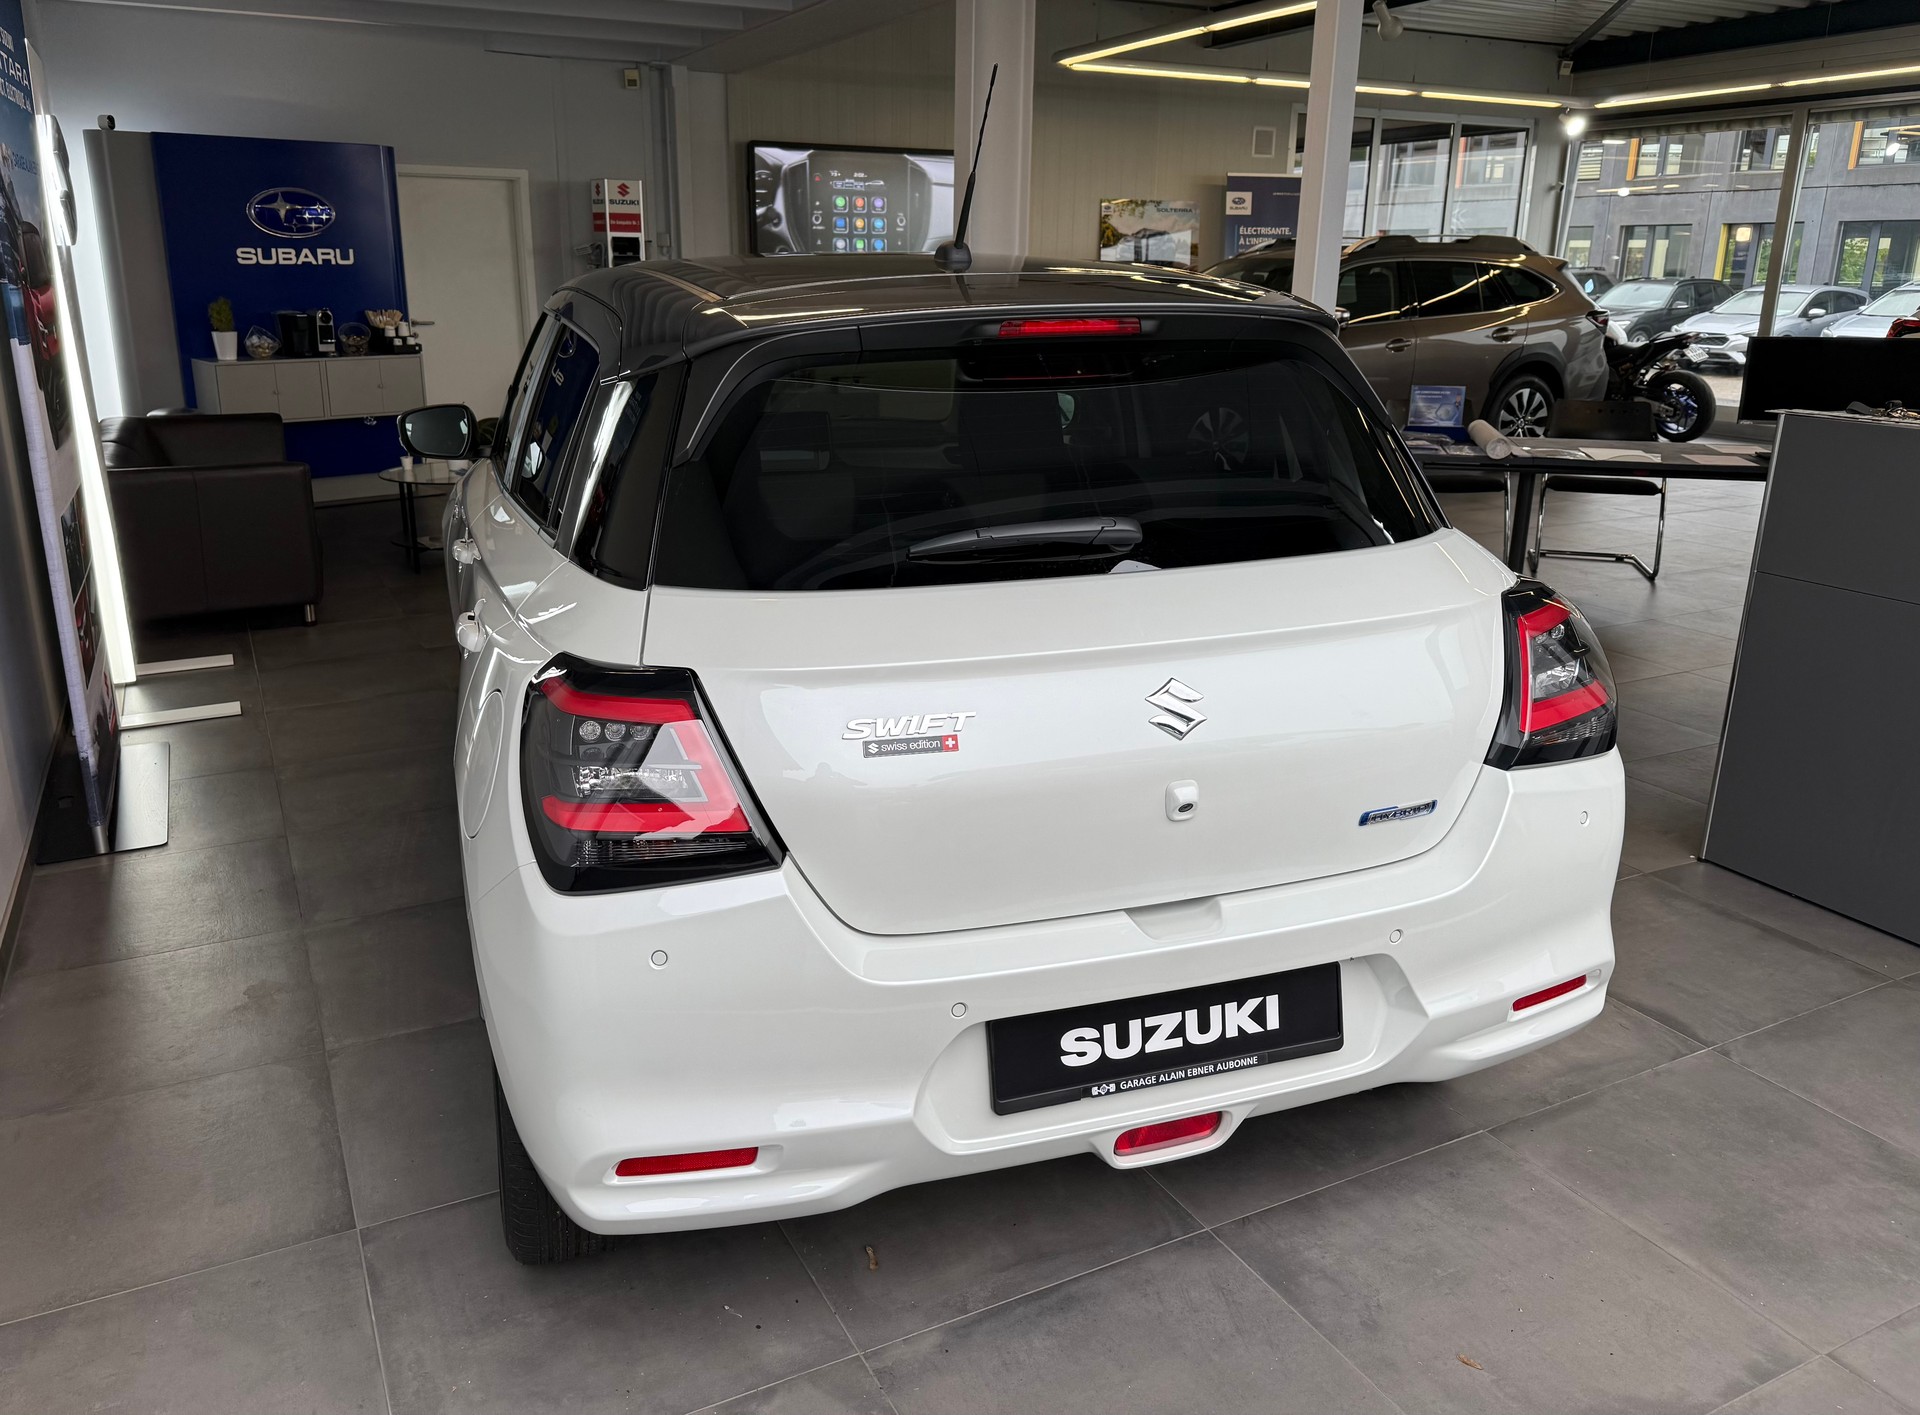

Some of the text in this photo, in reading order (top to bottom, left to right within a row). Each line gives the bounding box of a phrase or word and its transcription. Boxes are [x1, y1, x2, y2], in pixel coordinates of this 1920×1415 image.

[1238, 235, 1245, 245] À
[1239, 226, 1292, 235] ÉLECTRISANTE.
[236, 247, 355, 265] SUBARU
[842, 711, 977, 741] SWIFT
[881, 739, 941, 752] swiss edition
[1369, 803, 1432, 823] HYBRID
[1060, 994, 1280, 1067] SUZUKI
[1120, 1056, 1259, 1090] GARAGE ALAIN EBNER AUBONNE
